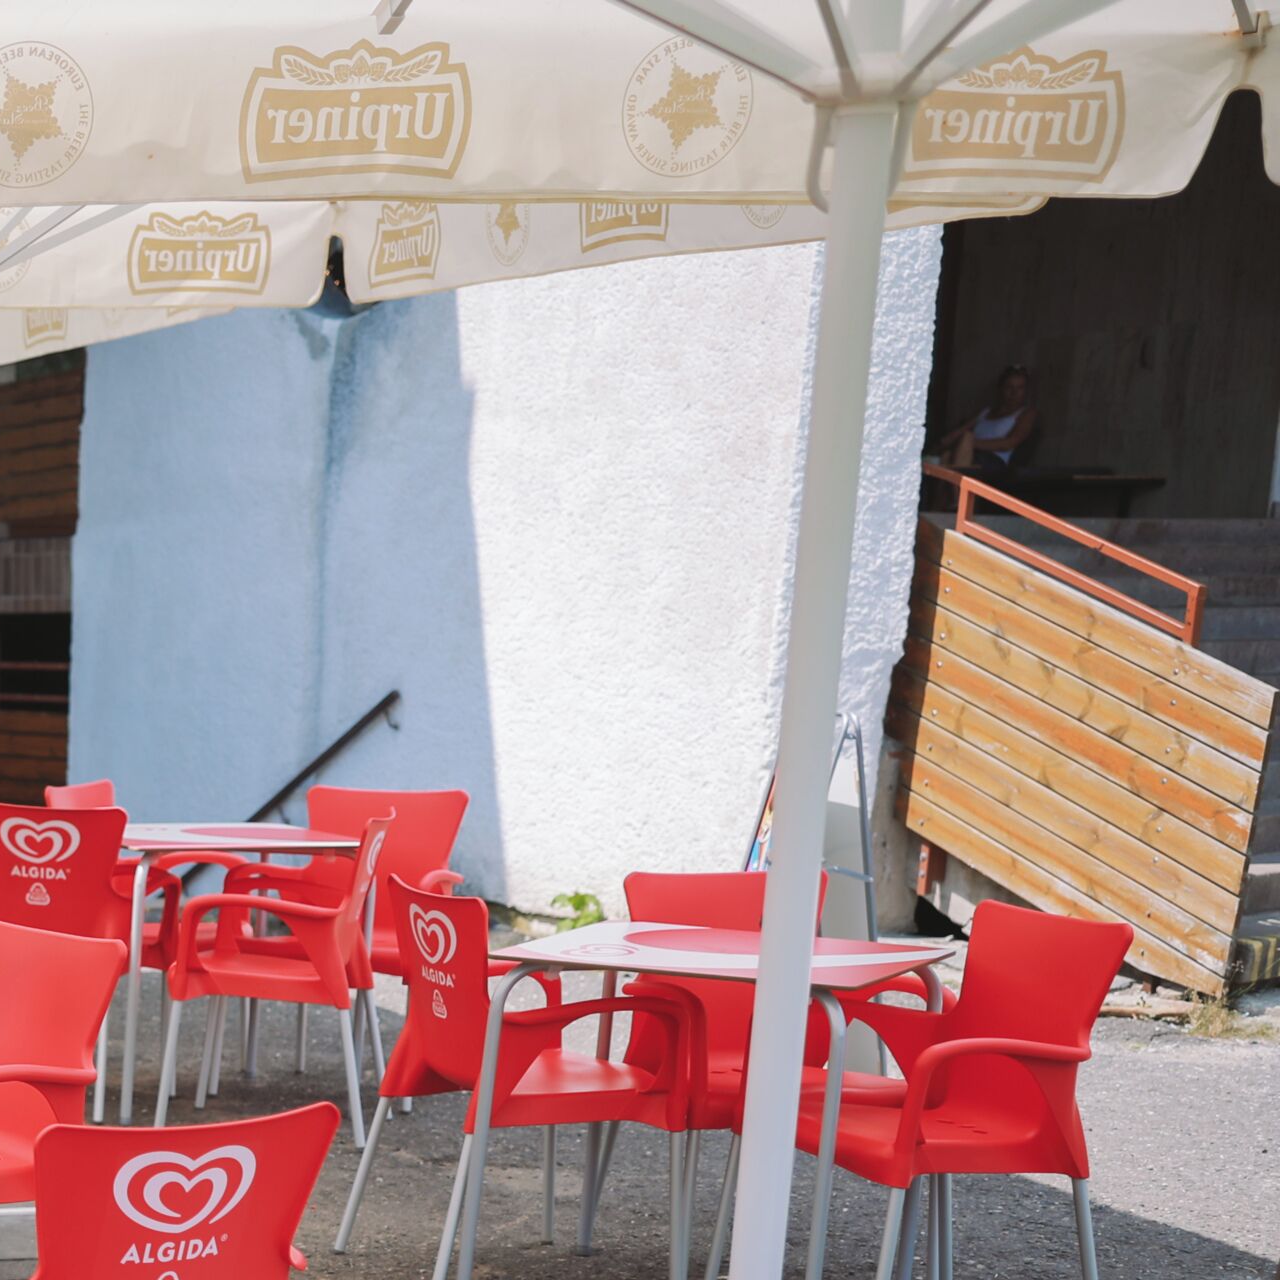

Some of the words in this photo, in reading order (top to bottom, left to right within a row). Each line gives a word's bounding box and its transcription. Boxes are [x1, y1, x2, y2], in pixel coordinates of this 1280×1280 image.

[10, 865, 67, 880] ALGIDA
[421, 965, 455, 988] ALGIDA
[120, 1236, 218, 1264] ALGIDA
